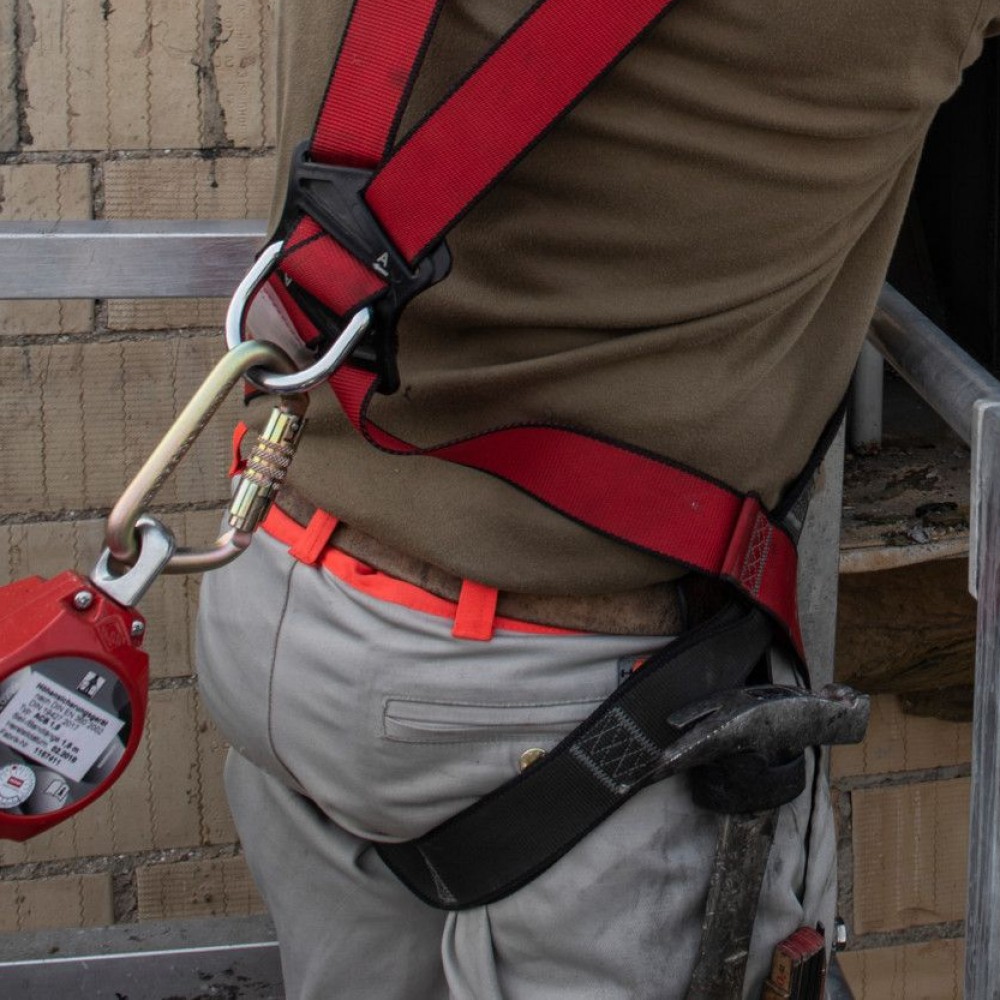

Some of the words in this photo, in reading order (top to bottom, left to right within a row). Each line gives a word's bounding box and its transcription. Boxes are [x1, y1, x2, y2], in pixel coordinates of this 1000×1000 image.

[376, 251, 389, 268] A
[28, 699, 43, 711] DIN
[50, 700, 64, 713] DIN
[64, 706, 75, 719] EN
